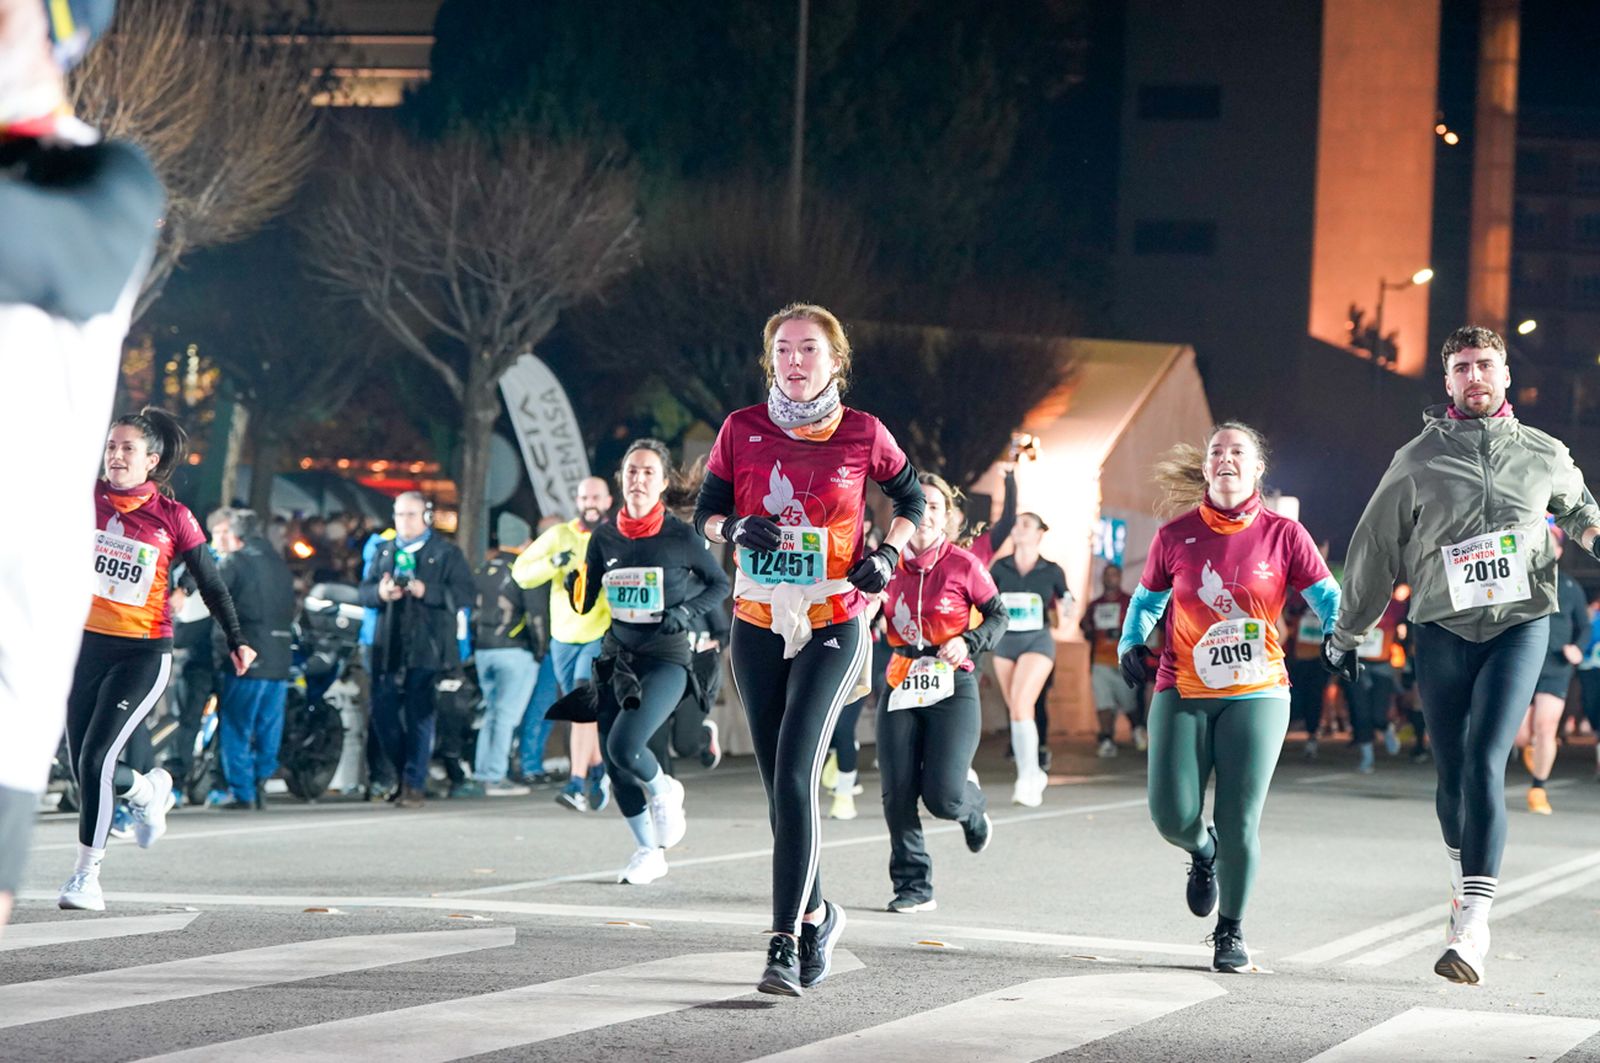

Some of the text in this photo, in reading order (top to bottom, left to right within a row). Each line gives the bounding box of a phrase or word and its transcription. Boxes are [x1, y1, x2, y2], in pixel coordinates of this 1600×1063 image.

[780, 505, 803, 526] 43
[1461, 544, 1483, 555] NOCHE
[1485, 541, 1493, 549] DE
[94, 554, 143, 584] 6959
[748, 550, 814, 577] 12451
[1454, 555, 1469, 565] SAN
[1463, 557, 1511, 584] 2018
[617, 586, 650, 604] 8770
[1213, 594, 1233, 613] 43
[902, 624, 917, 641] 43
[1209, 642, 1252, 666] 2019
[902, 674, 940, 690] 6184
